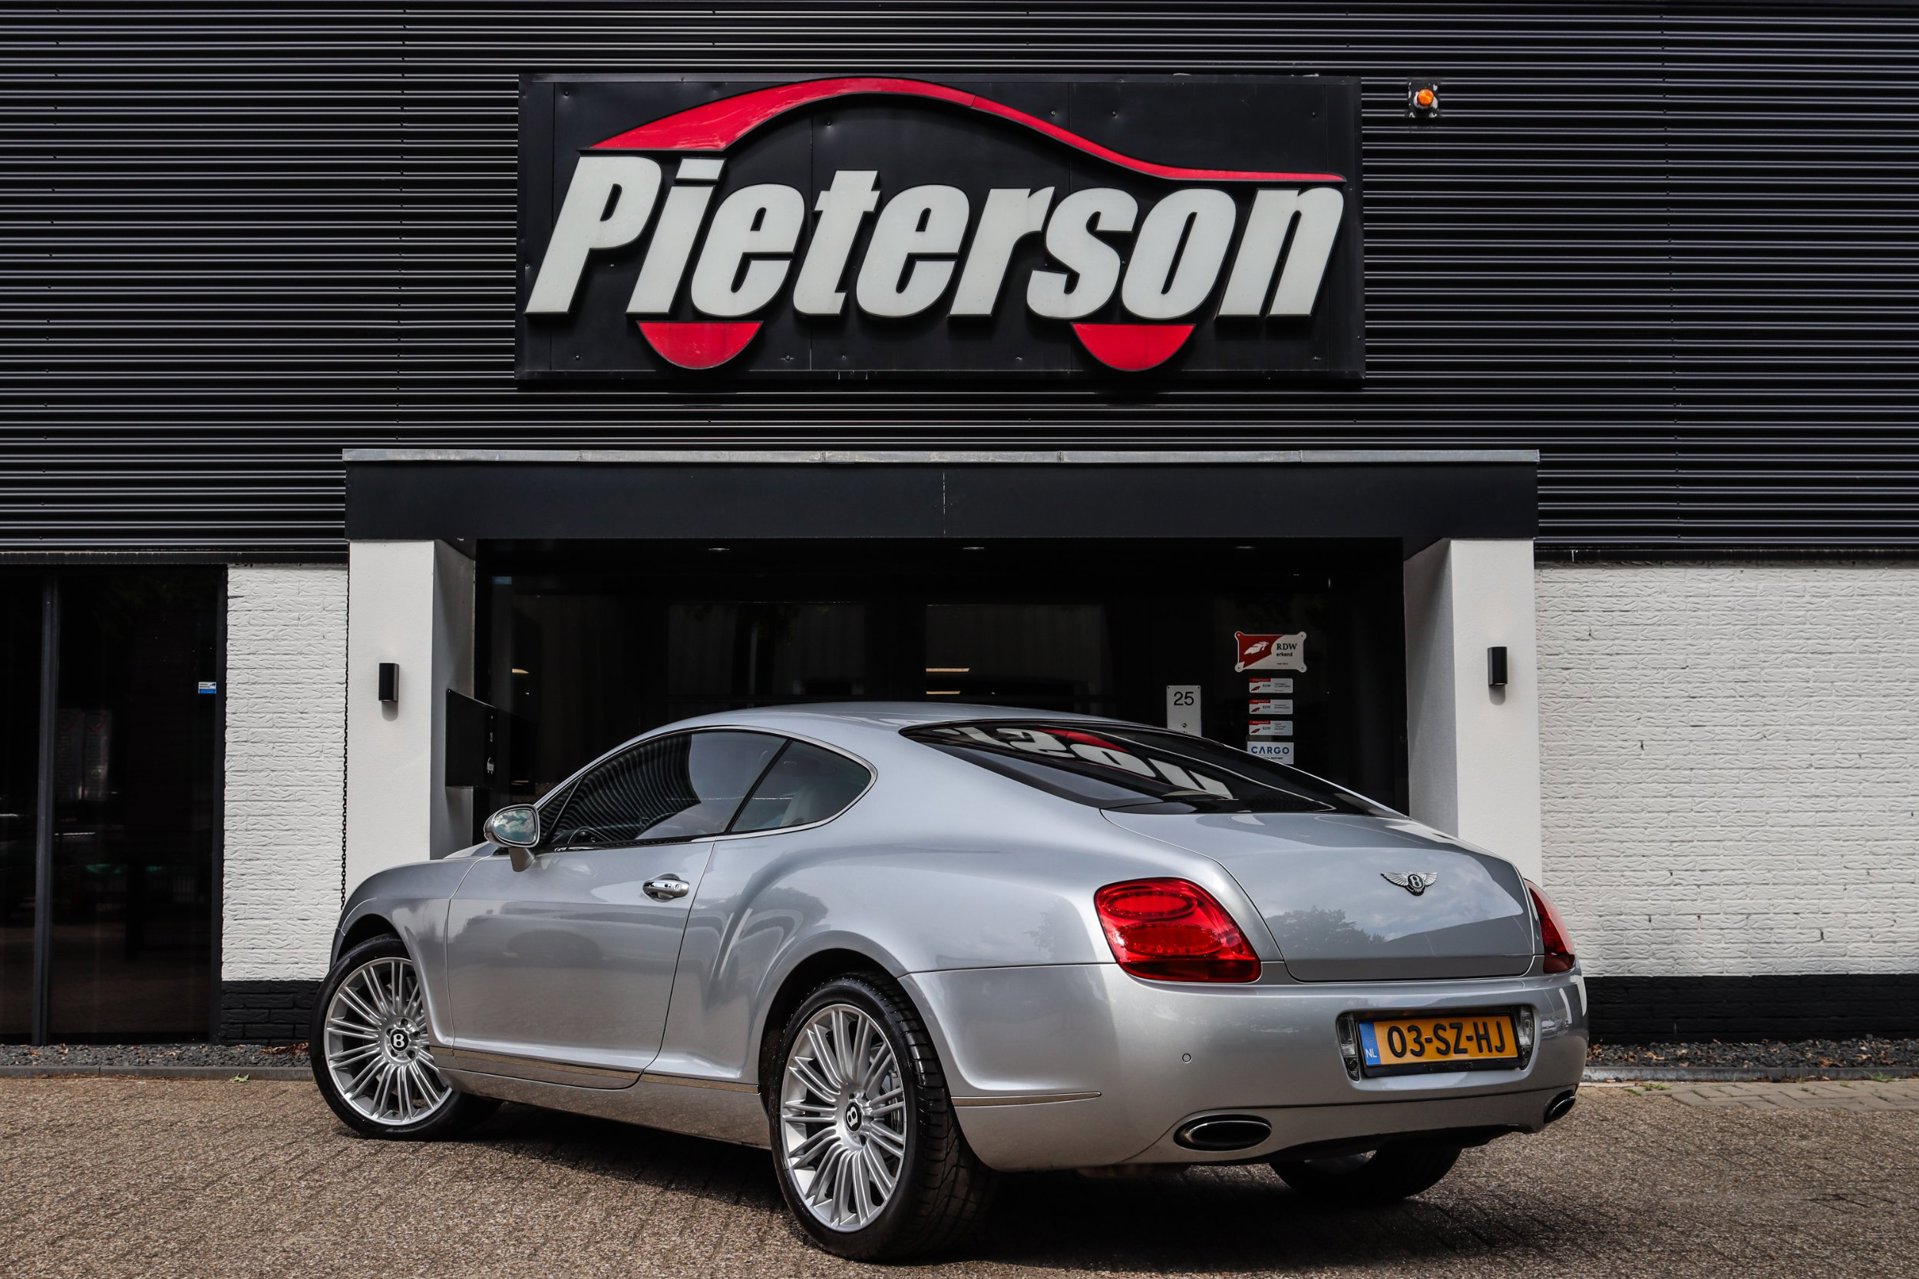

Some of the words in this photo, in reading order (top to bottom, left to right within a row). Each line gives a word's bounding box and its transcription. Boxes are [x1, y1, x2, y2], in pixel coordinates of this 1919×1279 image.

[525, 155, 1345, 319] Pieterson
[1276, 643, 1297, 651] RDW
[1173, 691, 1195, 706] 25
[1250, 746, 1290, 755] CARGO
[1387, 1020, 1506, 1059] 03-SZ-HJ
[1365, 1048, 1378, 1058] NL
